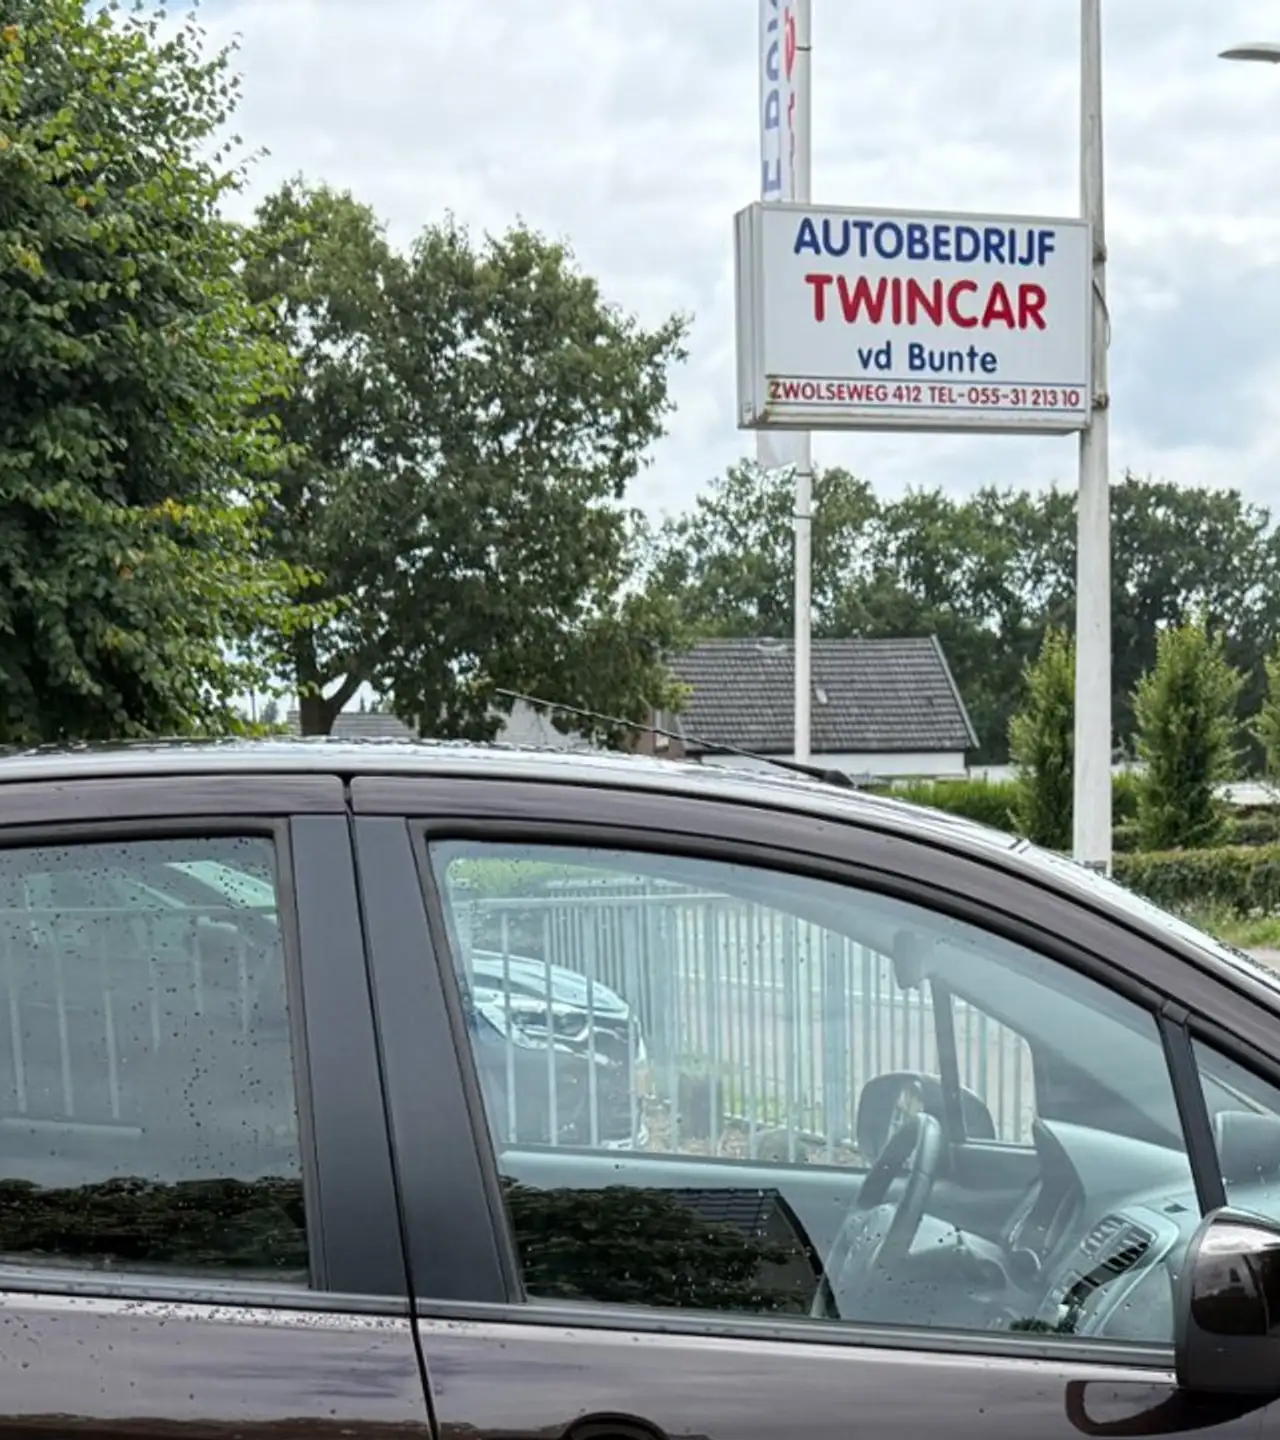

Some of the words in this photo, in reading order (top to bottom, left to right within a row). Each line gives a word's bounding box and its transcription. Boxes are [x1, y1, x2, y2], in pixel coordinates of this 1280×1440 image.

[793, 216, 1056, 267] AUTOBEDRIJF
[804, 273, 1048, 331] TWINCAR
[857, 340, 892, 370] vd
[908, 343, 998, 373] Bunte
[769, 380, 889, 402] ZWOLSEWEG
[892, 384, 923, 403] 412
